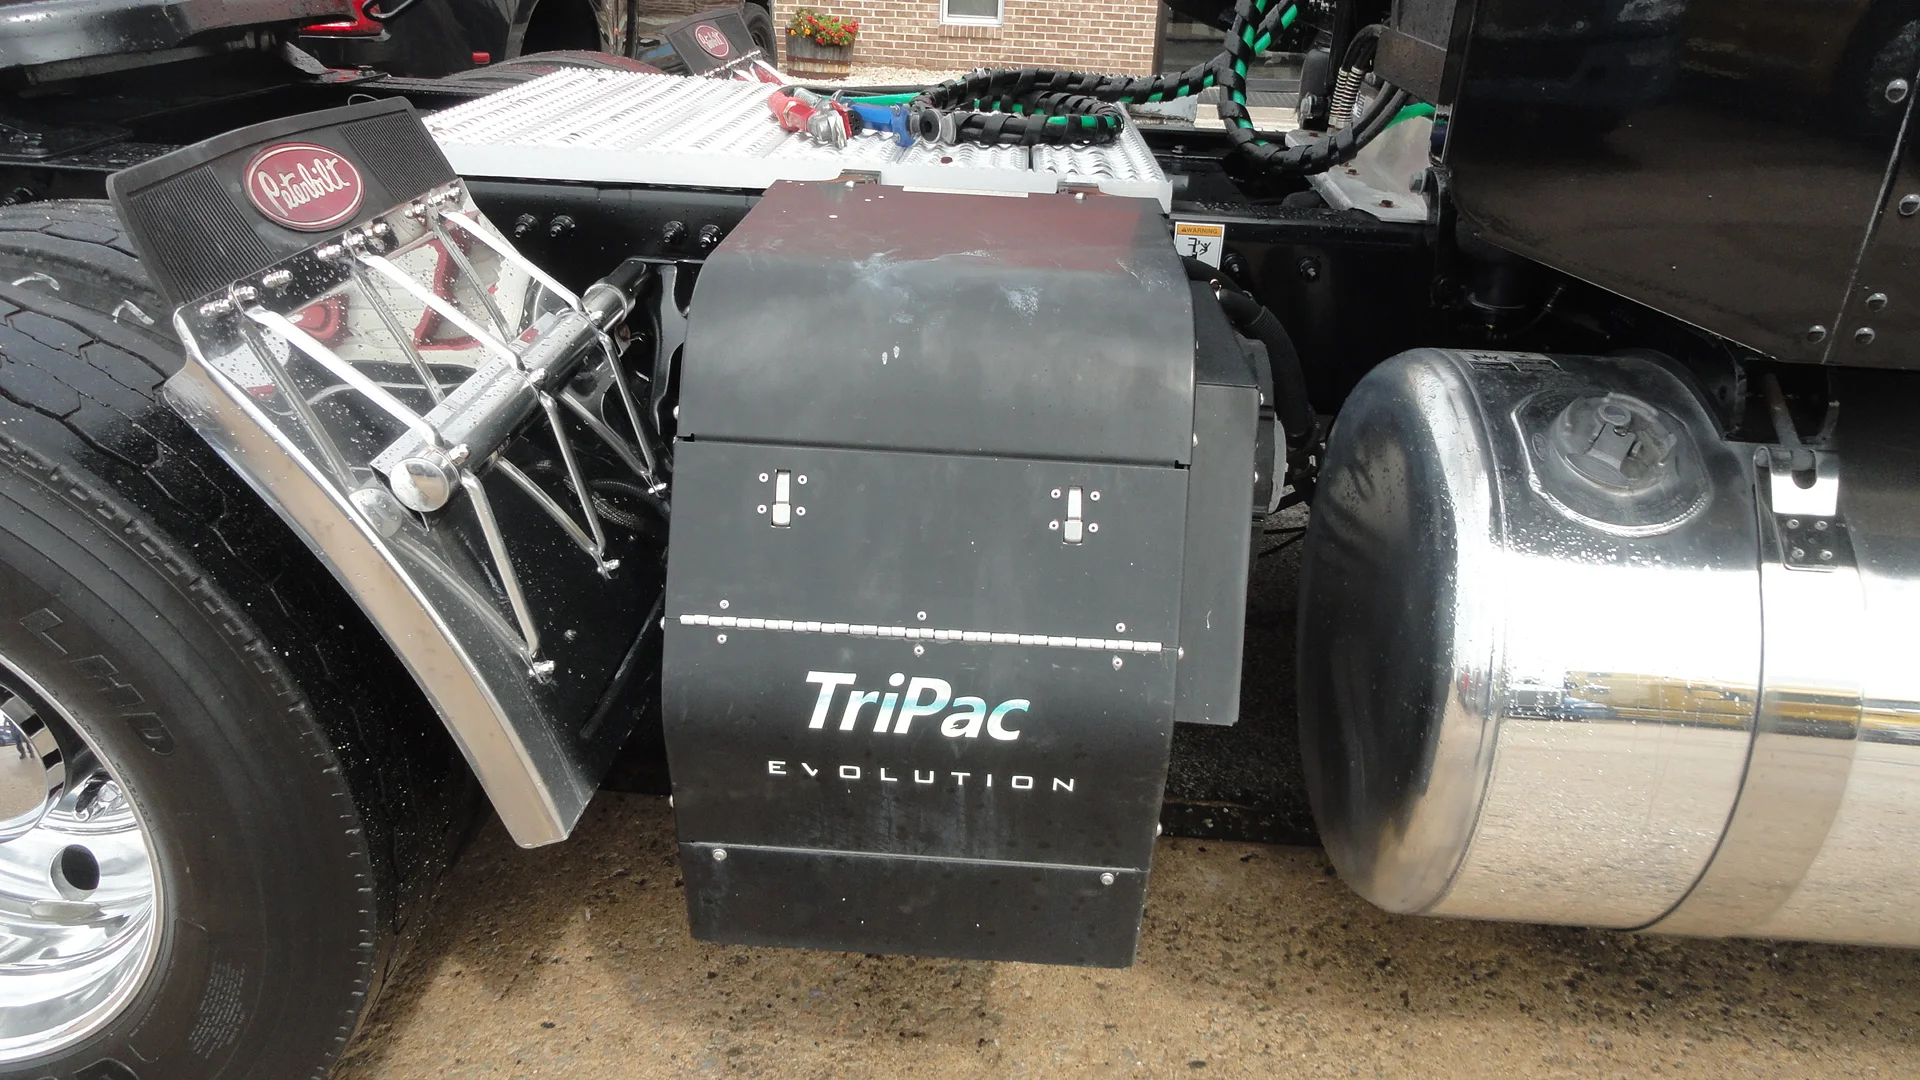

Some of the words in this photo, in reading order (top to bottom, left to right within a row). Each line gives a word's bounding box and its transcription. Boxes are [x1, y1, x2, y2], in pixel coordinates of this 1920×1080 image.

[258, 158, 351, 217] Peterbilt
[1187, 226, 1218, 234] WARNING
[805, 670, 1031, 741] TriPac
[768, 760, 1075, 792] EVOLUTION
